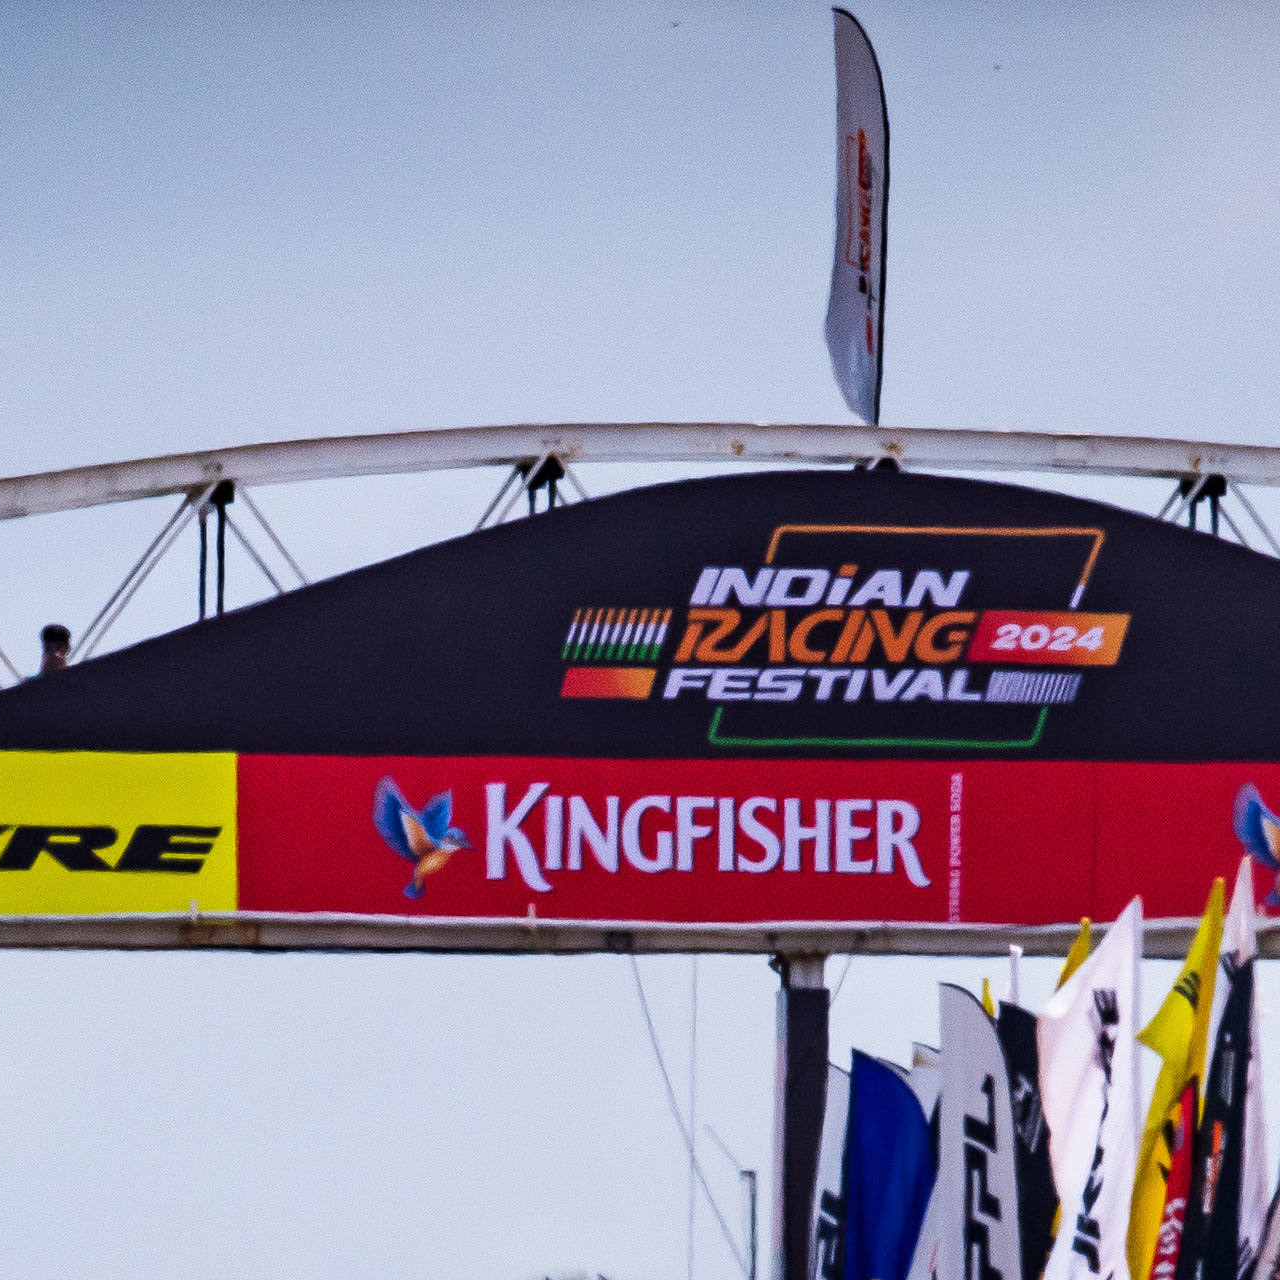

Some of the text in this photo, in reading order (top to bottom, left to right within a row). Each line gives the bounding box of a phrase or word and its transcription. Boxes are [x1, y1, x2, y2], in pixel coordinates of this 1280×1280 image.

[673, 608, 1105, 664] RACING 2024
[662, 667, 985, 703] FESTIVAL
[484, 781, 932, 893] KINGFISHER
